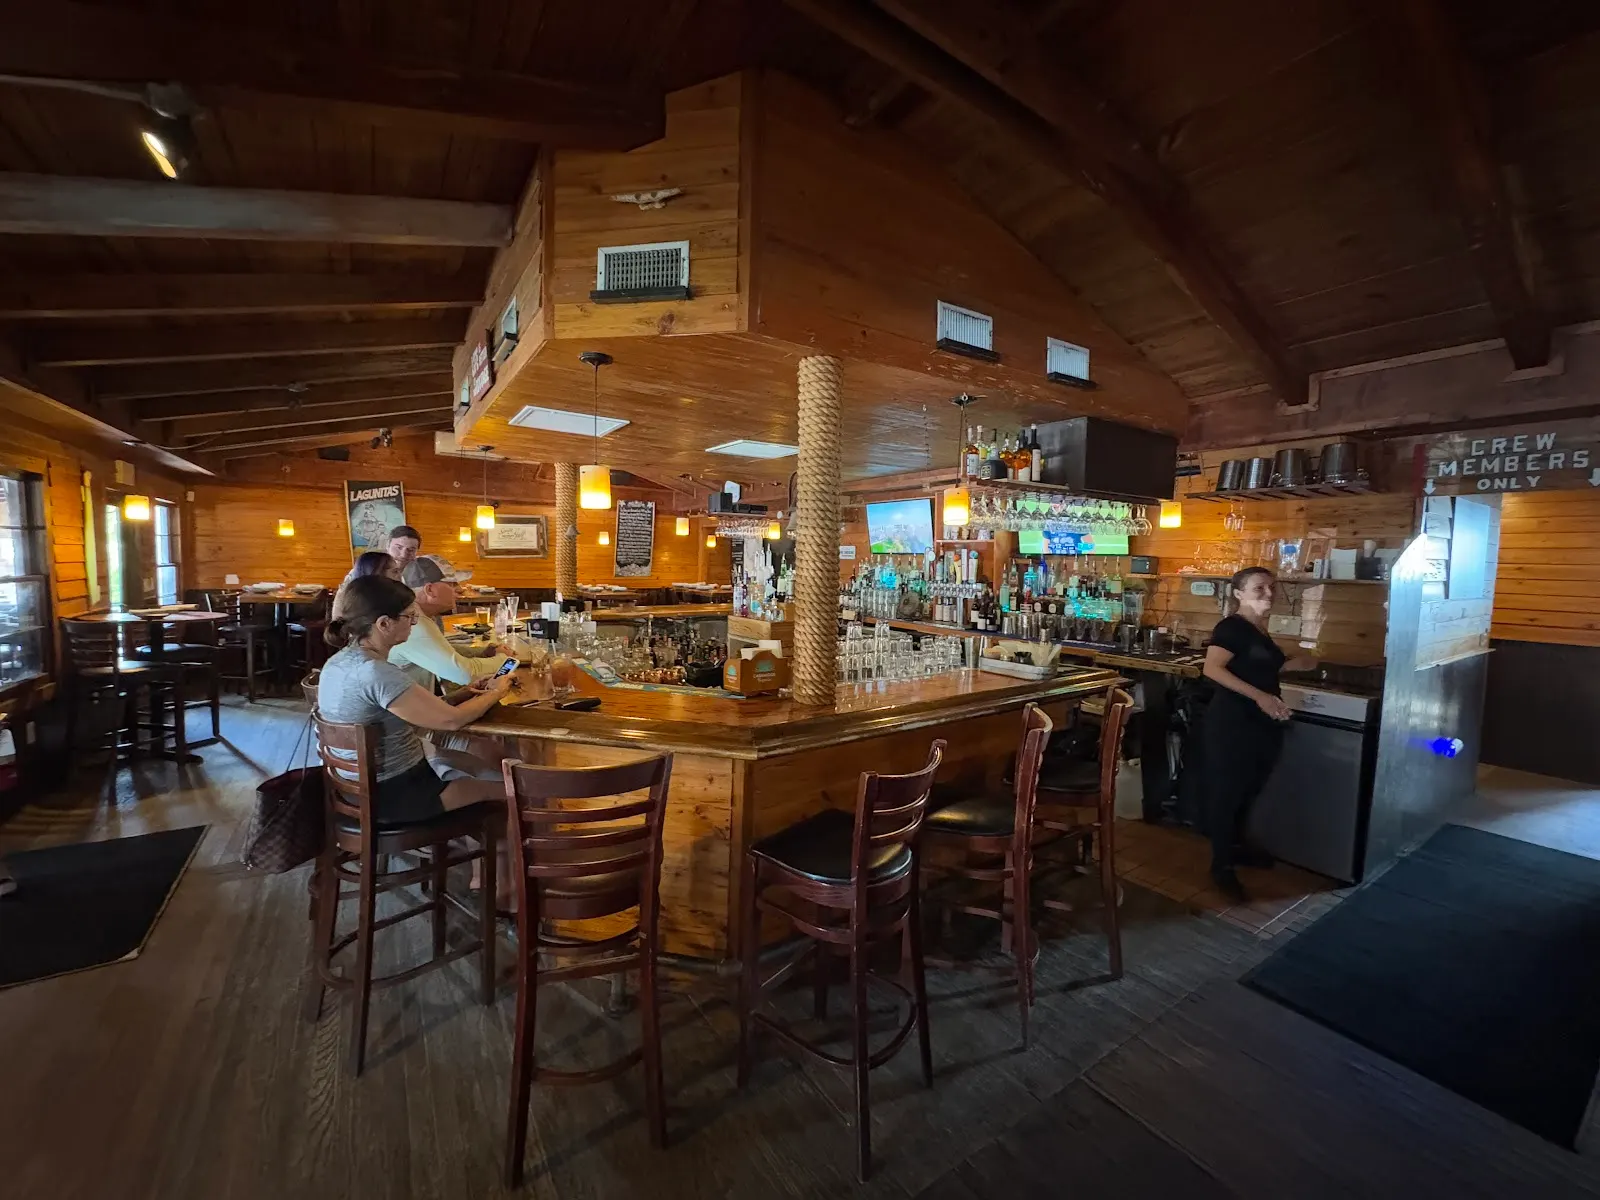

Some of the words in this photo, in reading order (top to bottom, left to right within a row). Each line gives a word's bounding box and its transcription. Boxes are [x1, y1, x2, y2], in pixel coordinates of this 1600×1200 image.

[1471, 432, 1557, 457] CREW
[1438, 450, 1589, 477] MEMBERS
[1476, 475, 1541, 490] ONLY
[350, 485, 400, 502] LAGUNITAS
